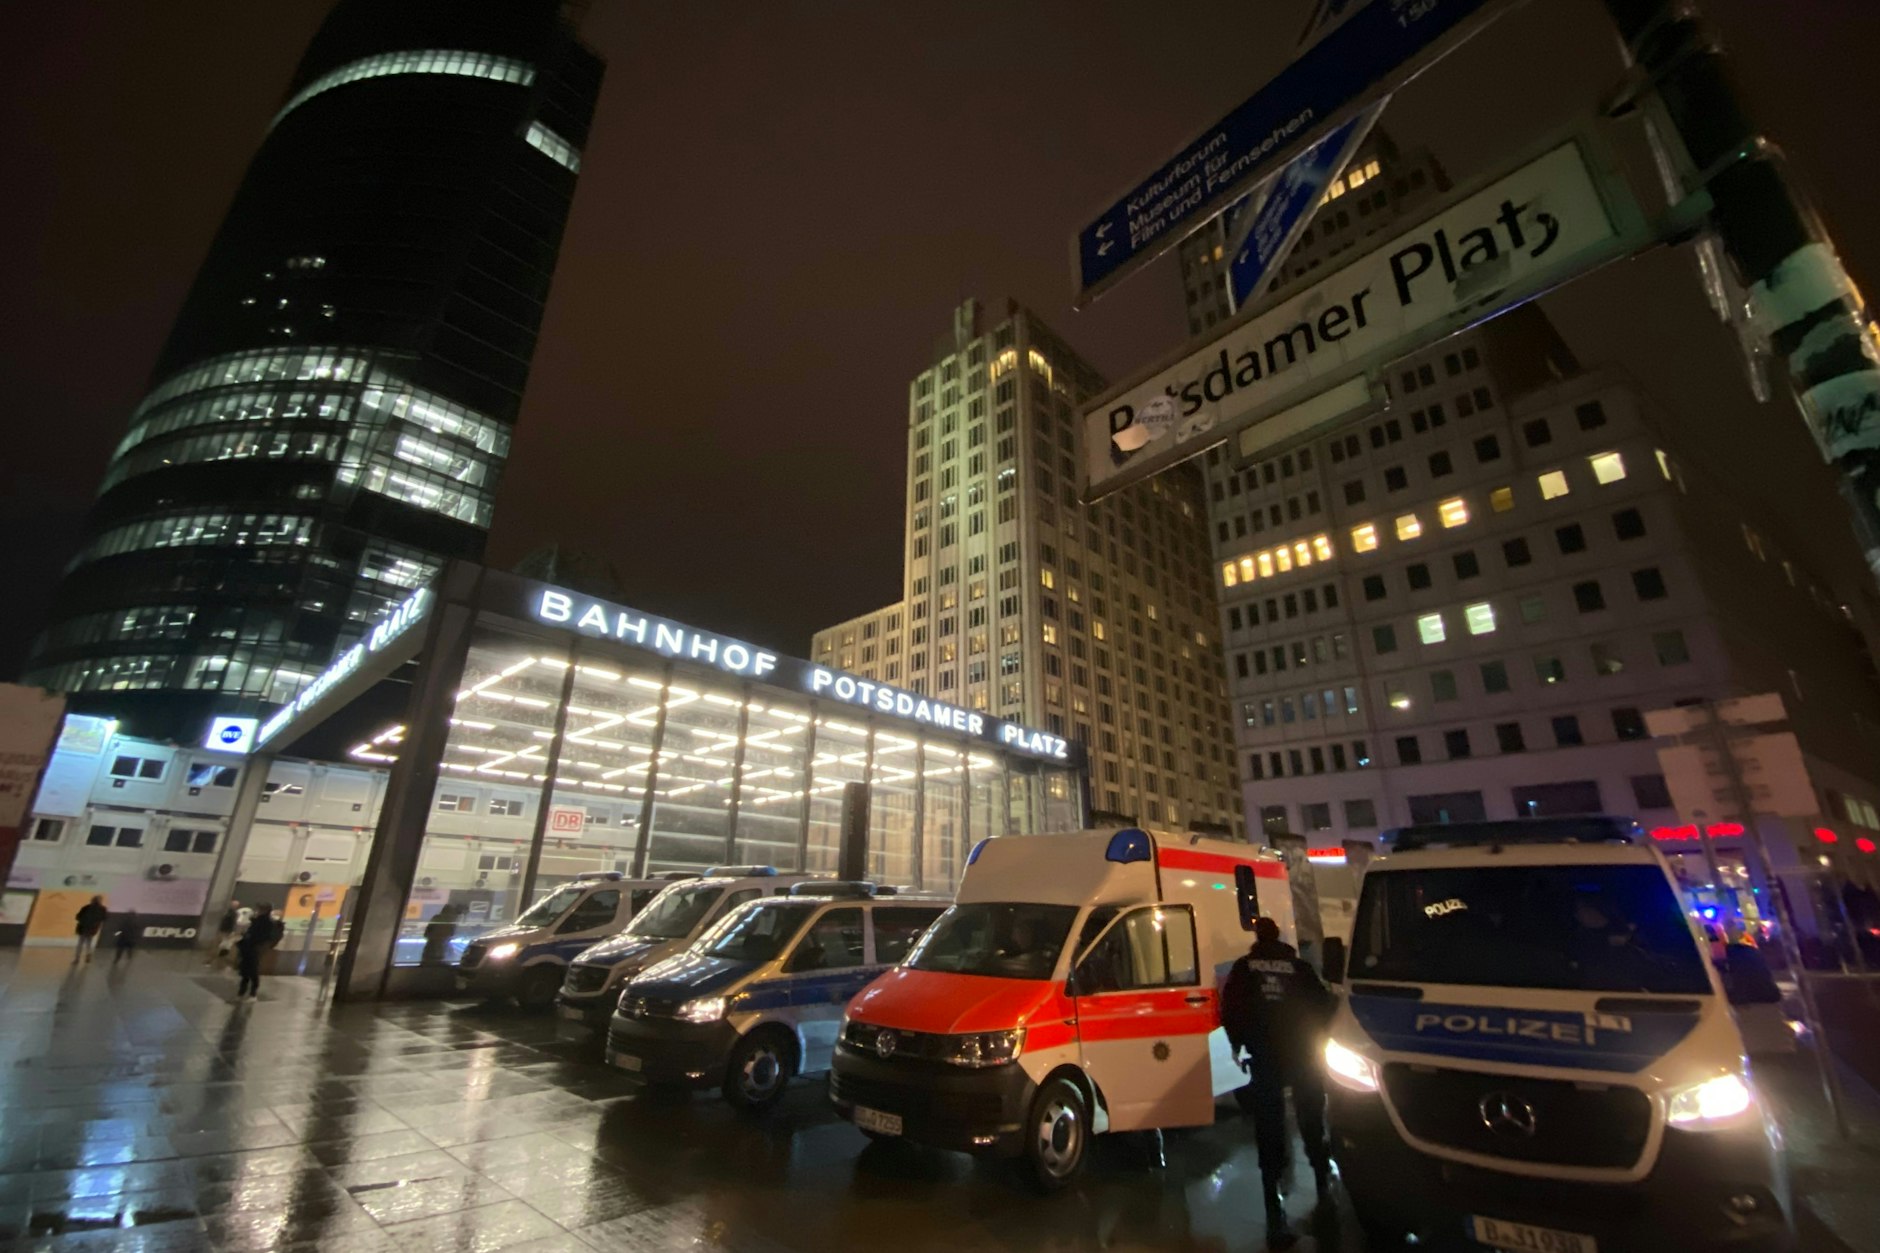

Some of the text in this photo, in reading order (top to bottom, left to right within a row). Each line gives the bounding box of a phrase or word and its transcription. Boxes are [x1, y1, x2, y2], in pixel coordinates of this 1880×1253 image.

[1127, 131, 1228, 216] Kulturforum
[1129, 150, 1229, 235] Museum für
[1131, 108, 1314, 249] Film und Fernsehen
[1109, 286, 1371, 460] Psdamer
[538, 589, 1069, 759] BAHNHOF POTSDAMER PLATZ
[142, 926, 197, 939] EXPLO
[1414, 1013, 1596, 1046] POLIZEI
